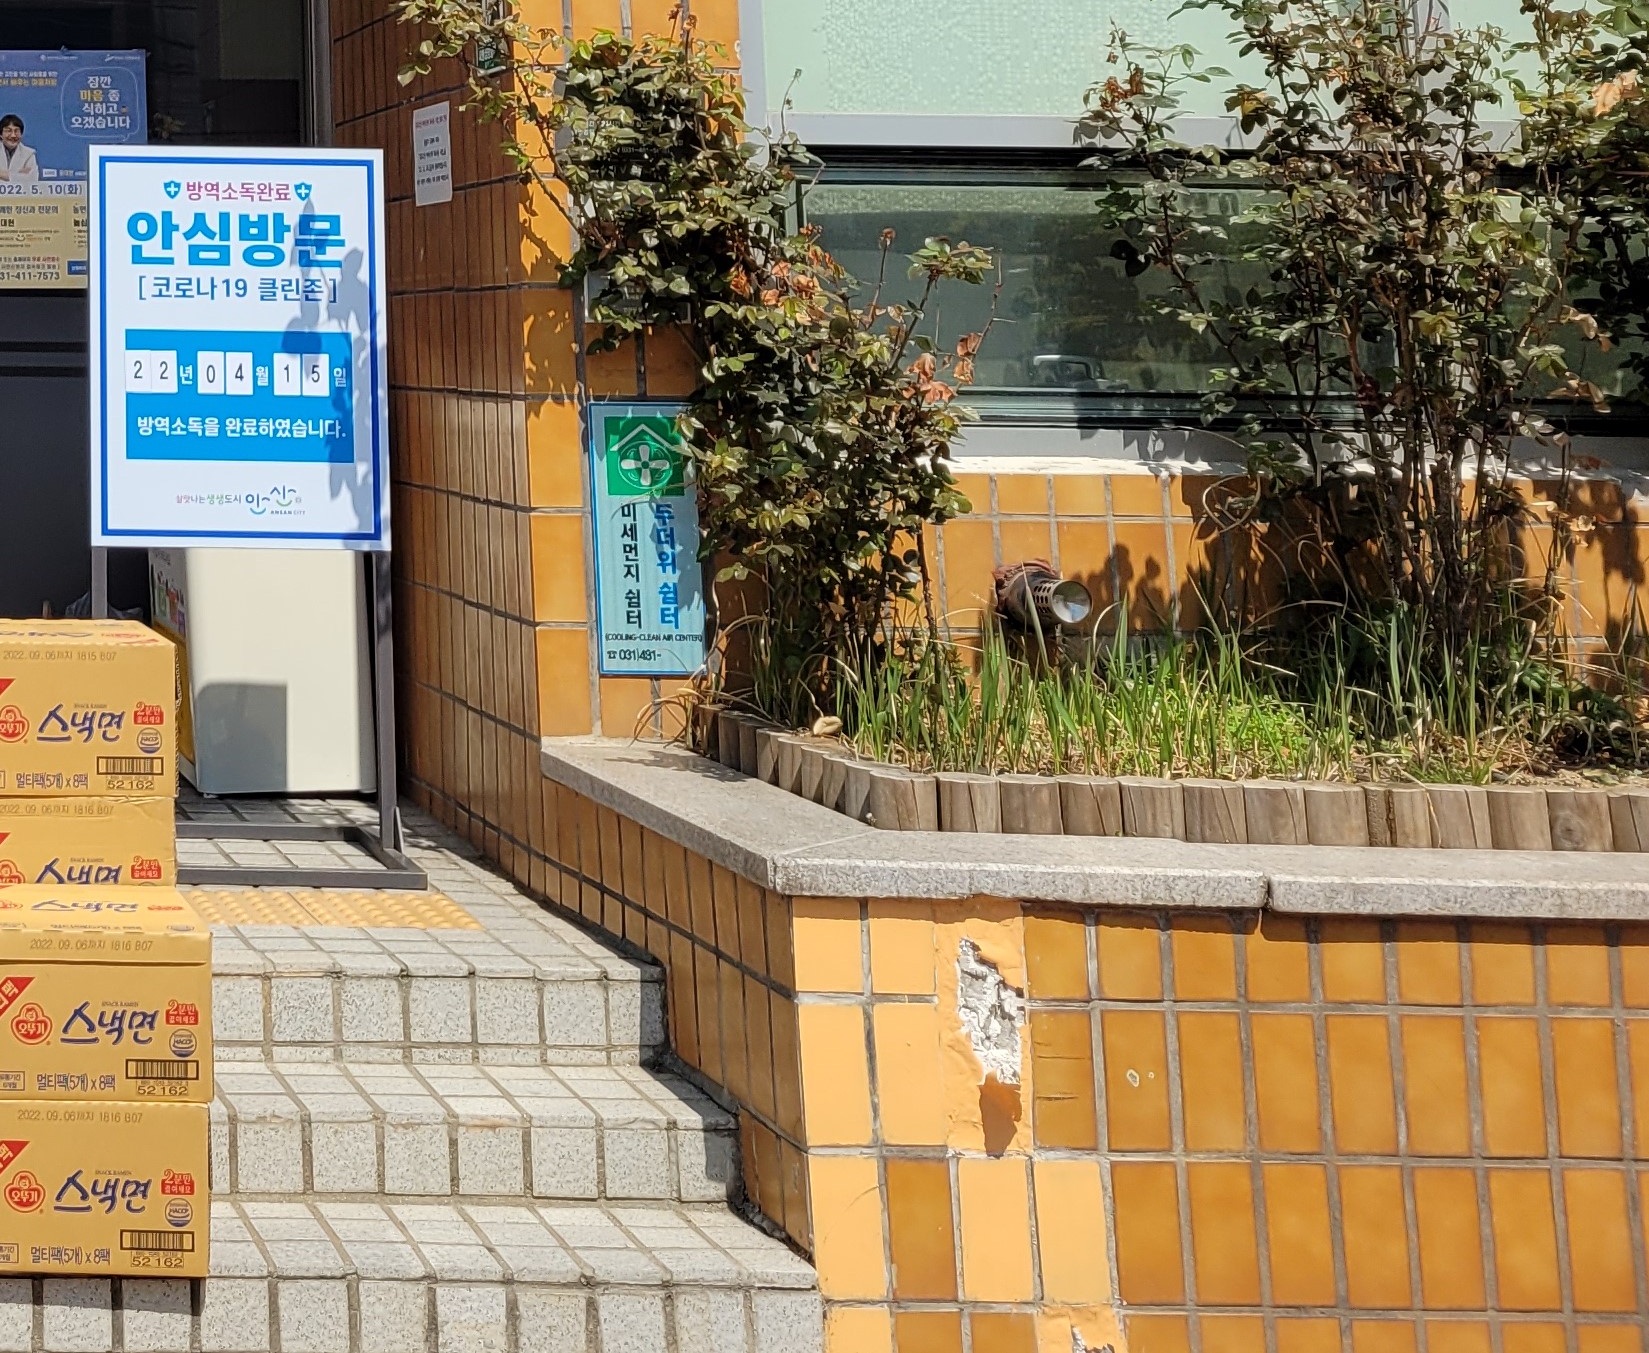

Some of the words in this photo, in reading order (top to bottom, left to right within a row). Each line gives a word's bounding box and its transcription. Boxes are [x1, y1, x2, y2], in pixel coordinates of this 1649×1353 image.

[87, 76, 111, 88] 잠깐
[79, 89, 103, 102] 마음
[82, 103, 118, 115] 식히고
[71, 116, 131, 129] 오겠습니다
[32, 185, 42, 195] 5.
[48, 184, 82, 195] 10(화)
[186, 181, 291, 202] 방역소독완료
[127, 210, 345, 267] 안심방문
[137, 416, 220, 437] 방역소독을
[225, 417, 346, 438] 완료하였습니다.
[621, 503, 640, 583] 미세먼지
[624, 588, 642, 629] 쉼터
[658, 582, 679, 630] 쉼터
[36, 700, 127, 744] 스낵면
[59, 1000, 159, 1046] 스낵면
[11, 1191, 38, 1204] 오뚜기
[53, 1166, 154, 1215] 스낵면
